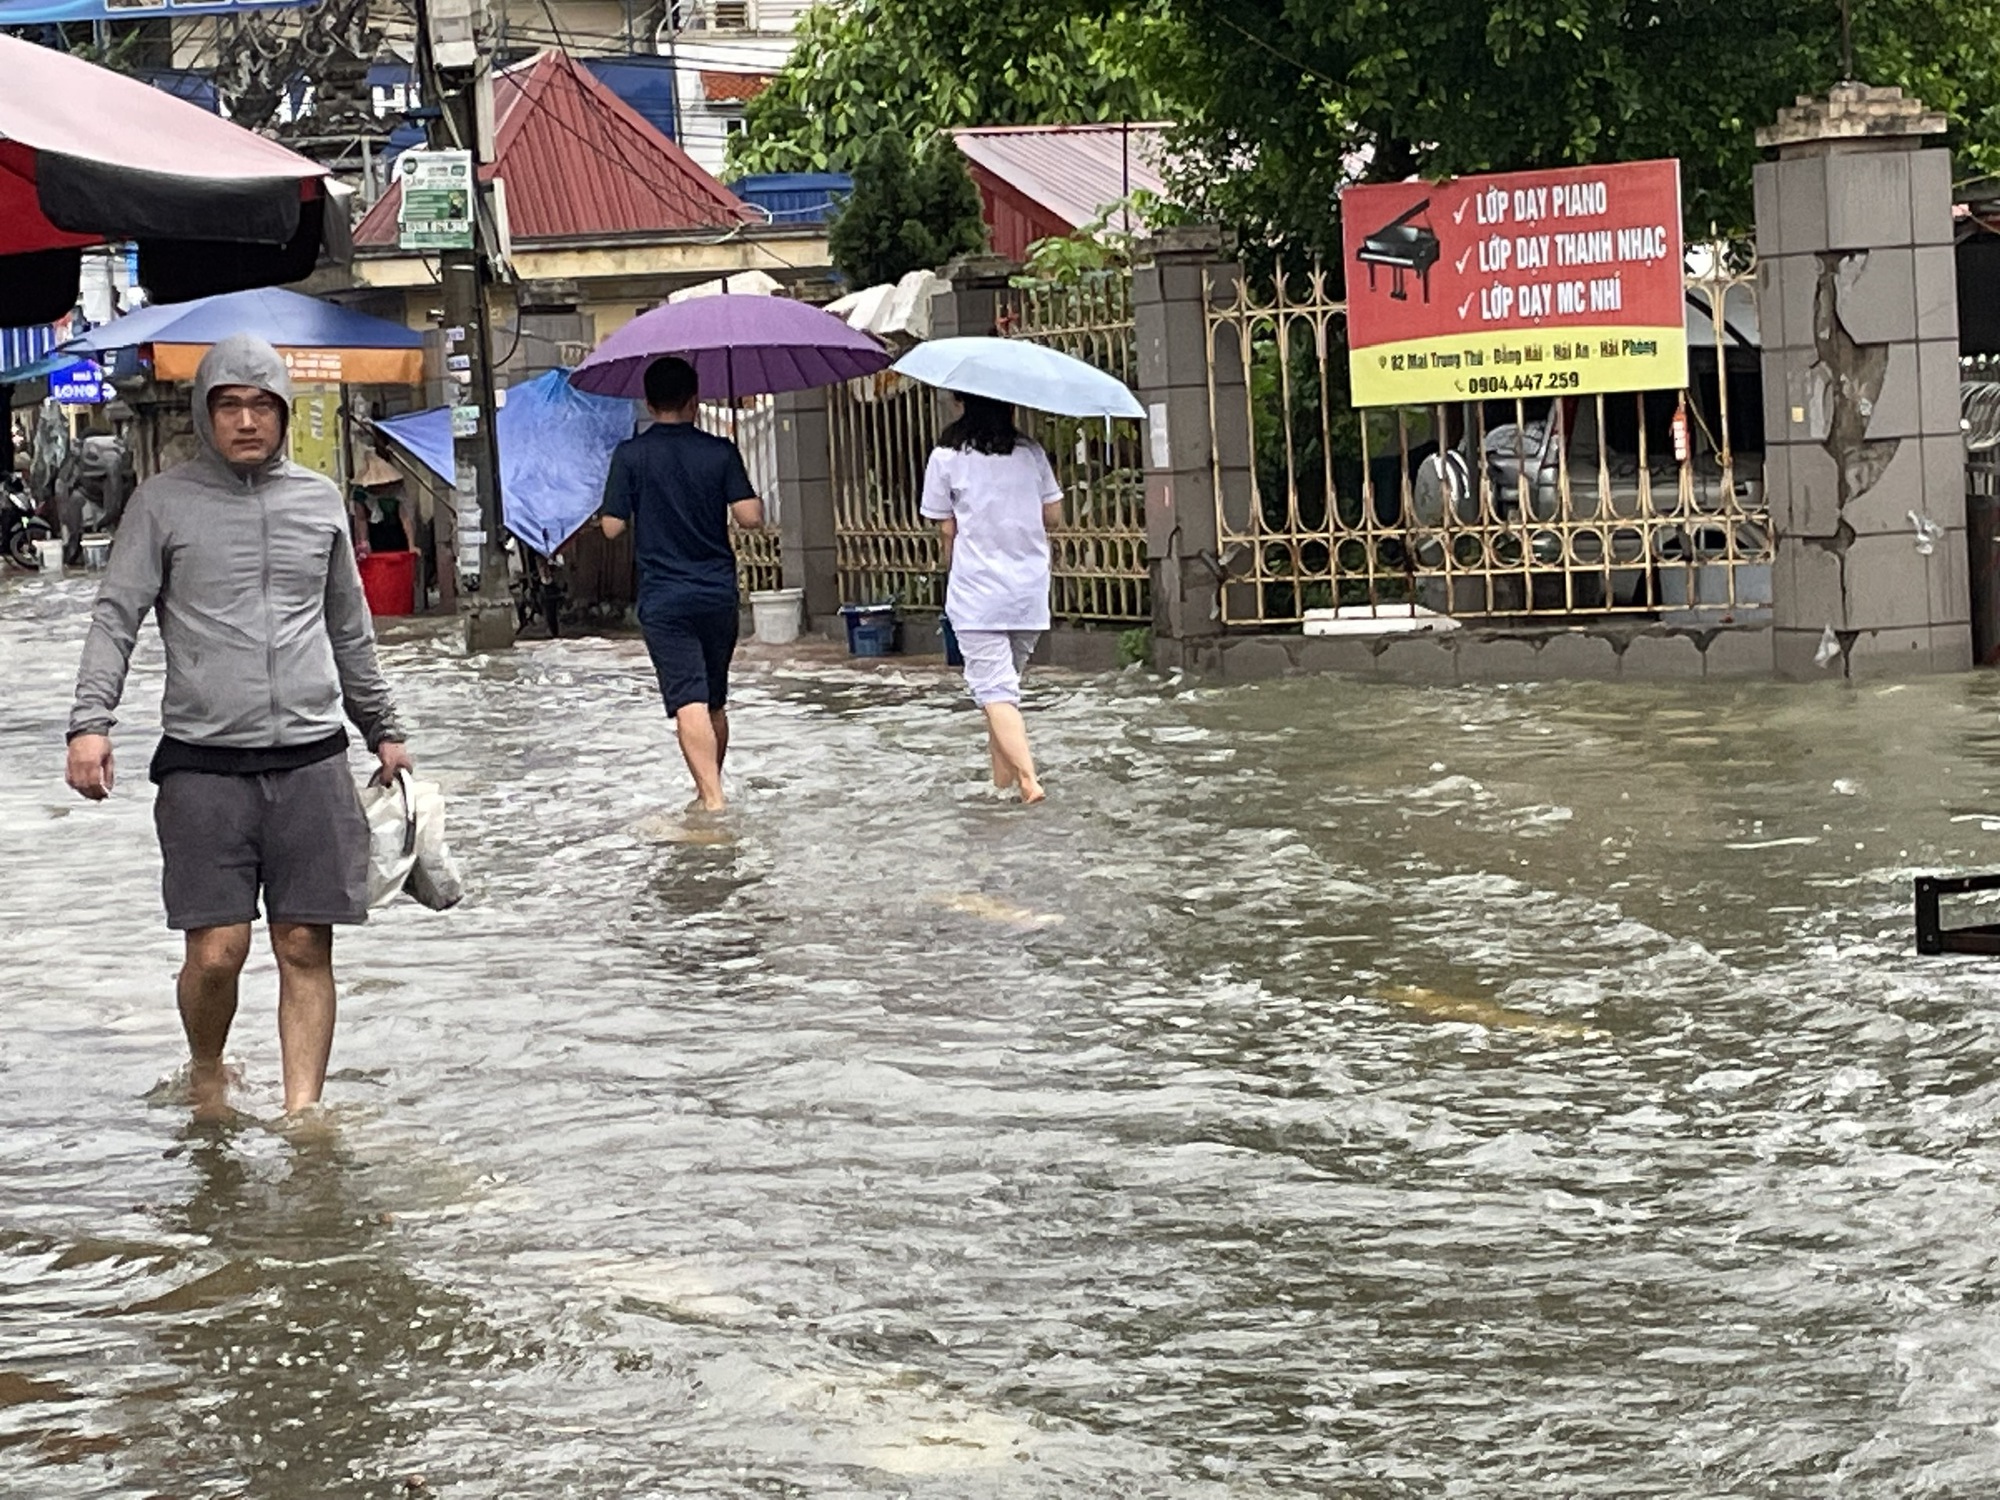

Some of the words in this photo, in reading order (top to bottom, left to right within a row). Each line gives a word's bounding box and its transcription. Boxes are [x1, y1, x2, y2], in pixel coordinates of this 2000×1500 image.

[1476, 184, 1509, 224] LỚP
[1514, 187, 1547, 228] DẠY
[1552, 181, 1607, 218] PIANO
[1478, 233, 1511, 272] LỚP
[1516, 235, 1550, 276] DẠY
[1554, 230, 1613, 266] THANH
[1617, 226, 1667, 267] NHẠC
[1481, 280, 1514, 320] LỚP
[1518, 283, 1552, 324] DẠY
[1557, 281, 1586, 315] MC
[1590, 270, 1622, 312] NHÍ
[1407, 352, 1428, 369] Mai
[1430, 352, 1461, 369] Trung
[1468, 371, 1580, 394] 0904.447.259
